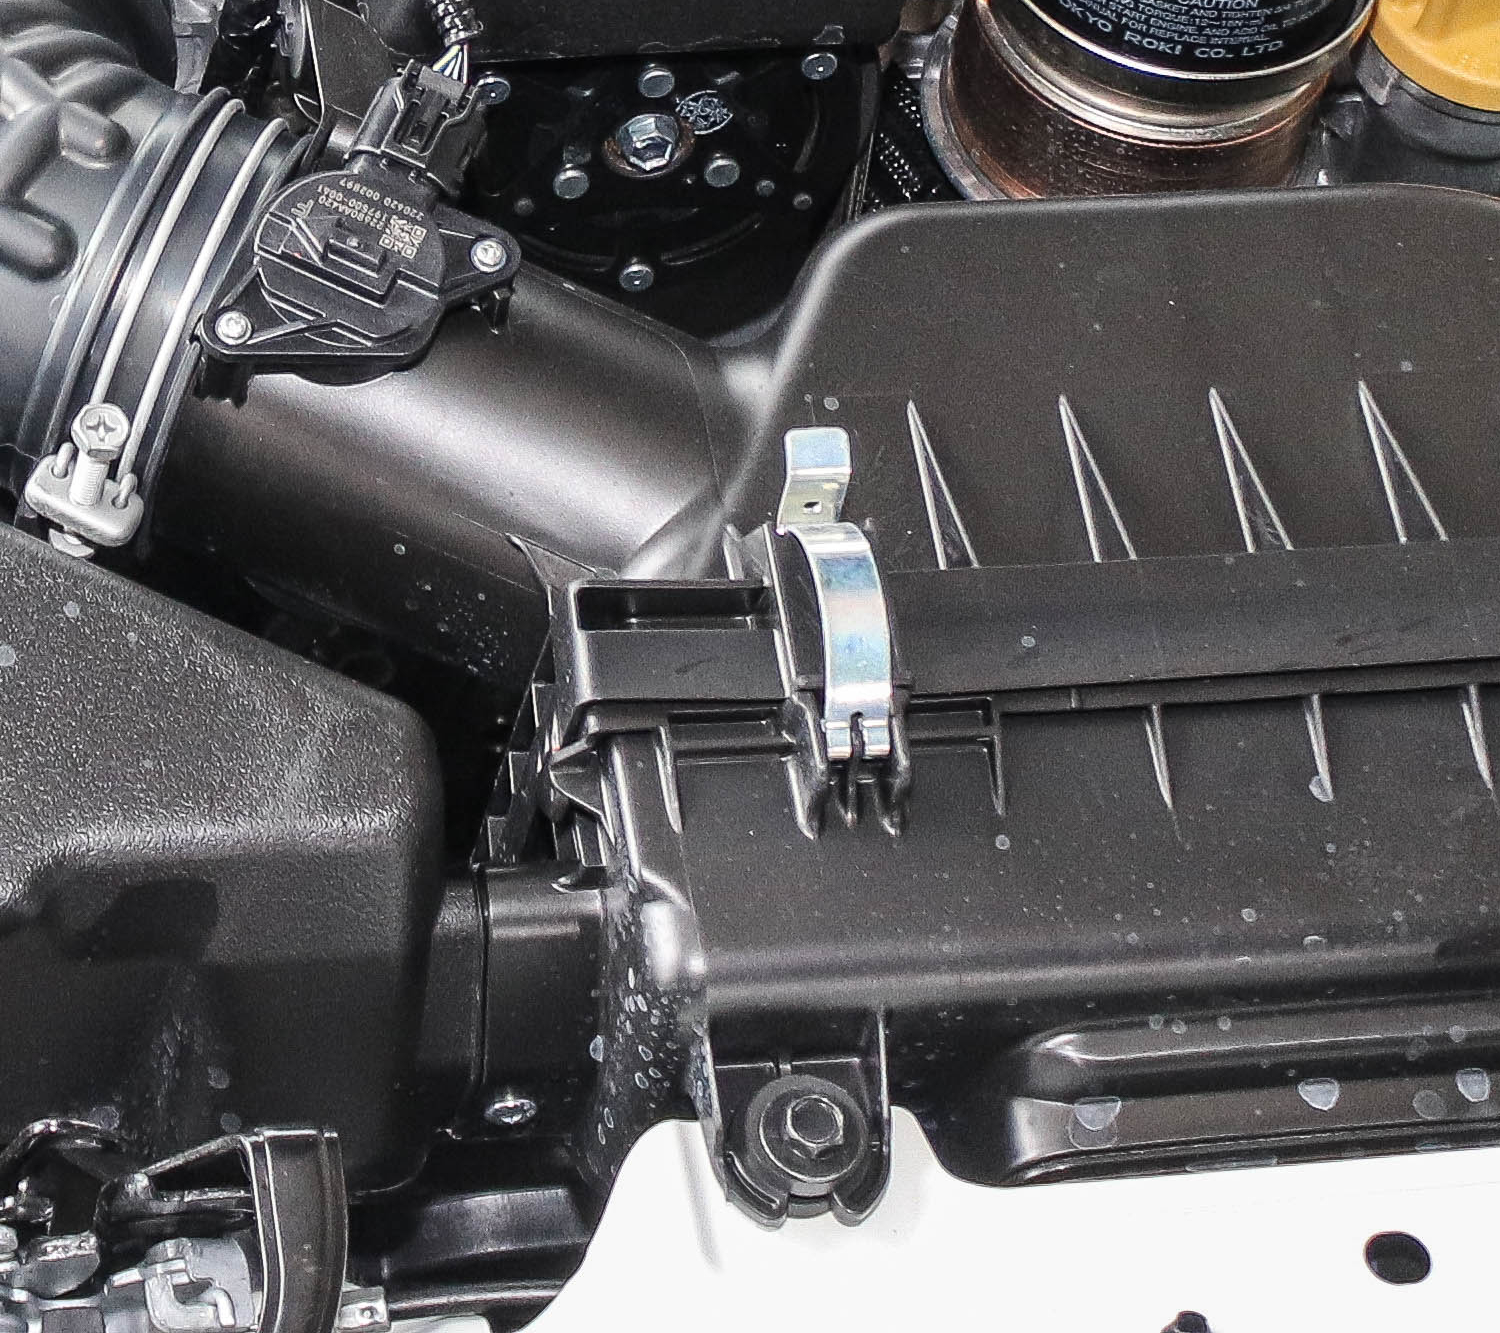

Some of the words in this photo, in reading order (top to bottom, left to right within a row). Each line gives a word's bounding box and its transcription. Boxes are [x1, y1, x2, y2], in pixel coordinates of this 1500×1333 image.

[1109, 1, 1147, 21] START
[1150, 18, 1198, 34] ENGINE
[1190, 8, 1218, 18] AND
[1121, 17, 1147, 32] FOR
[1149, 27, 1207, 44] REPLACE
[1124, 31, 1182, 55] ROKI
